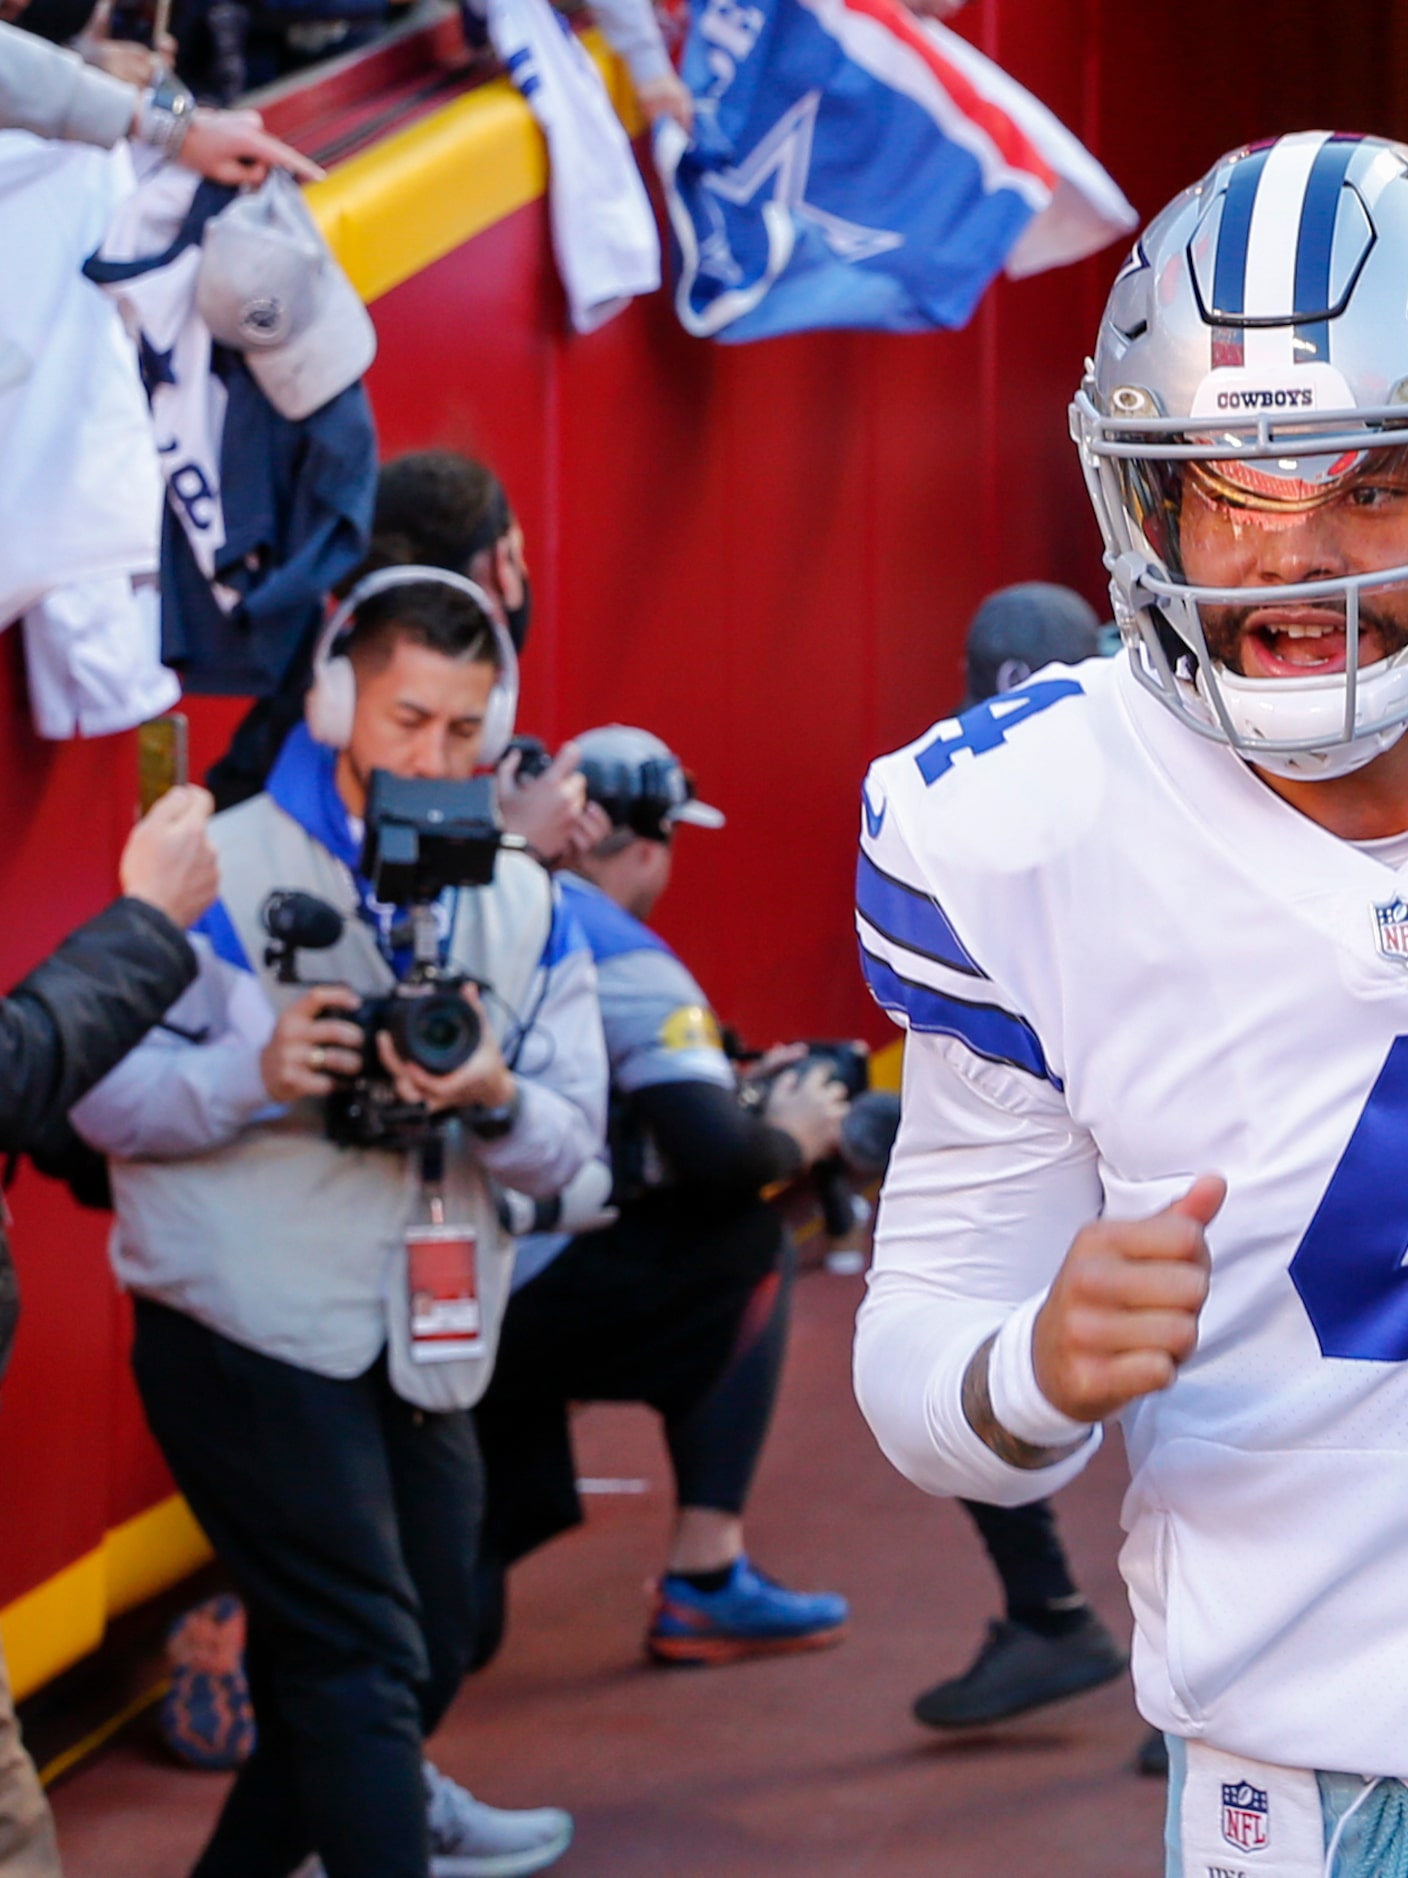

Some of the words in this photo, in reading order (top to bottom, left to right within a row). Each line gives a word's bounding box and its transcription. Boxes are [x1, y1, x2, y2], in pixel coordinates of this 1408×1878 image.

[1217, 388, 1313, 409] COWBOYS
[914, 679, 1087, 787] 4
[1225, 1808, 1266, 1848] NFL
